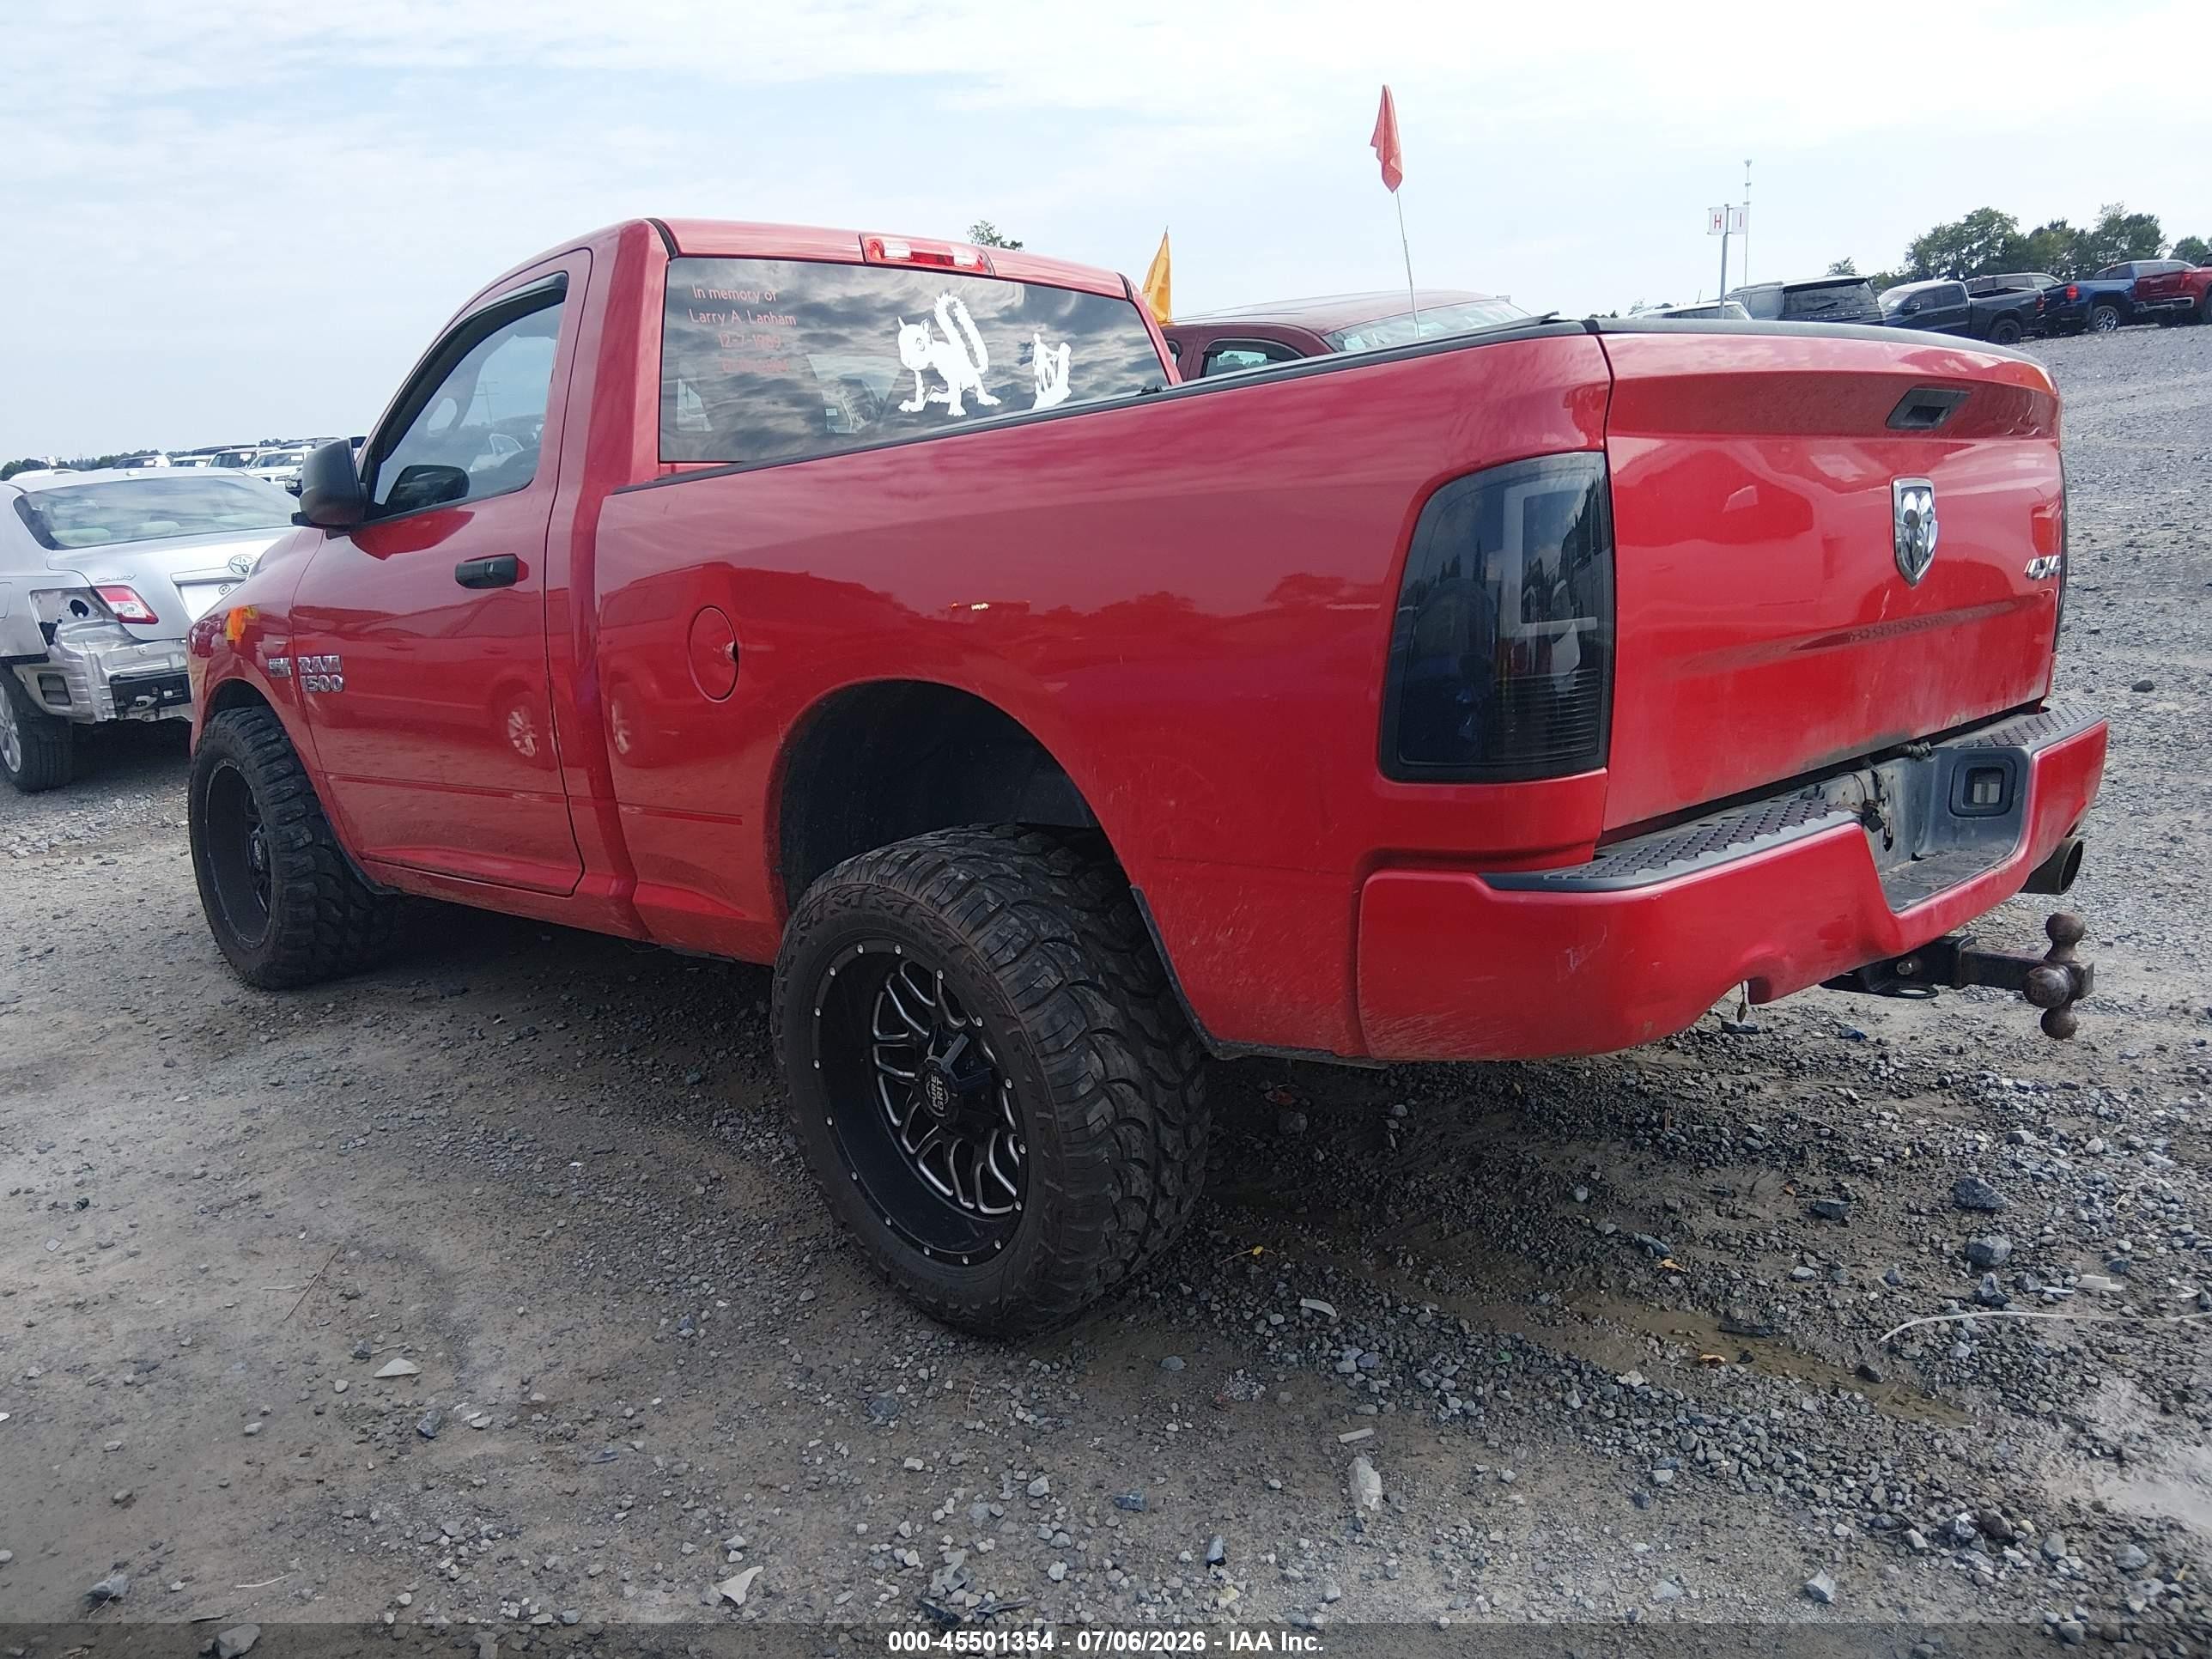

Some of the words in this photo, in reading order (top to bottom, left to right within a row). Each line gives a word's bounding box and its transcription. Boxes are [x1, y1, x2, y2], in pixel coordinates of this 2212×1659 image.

[1713, 214, 1723, 229] H
[692, 284, 706, 300] In
[708, 288, 760, 304] memory
[764, 289, 777, 301] of
[689, 308, 726, 326] Larry
[731, 309, 745, 324] A.
[747, 309, 798, 325] Lanham
[297, 654, 342, 673] RAM
[300, 673, 344, 693] 1500
